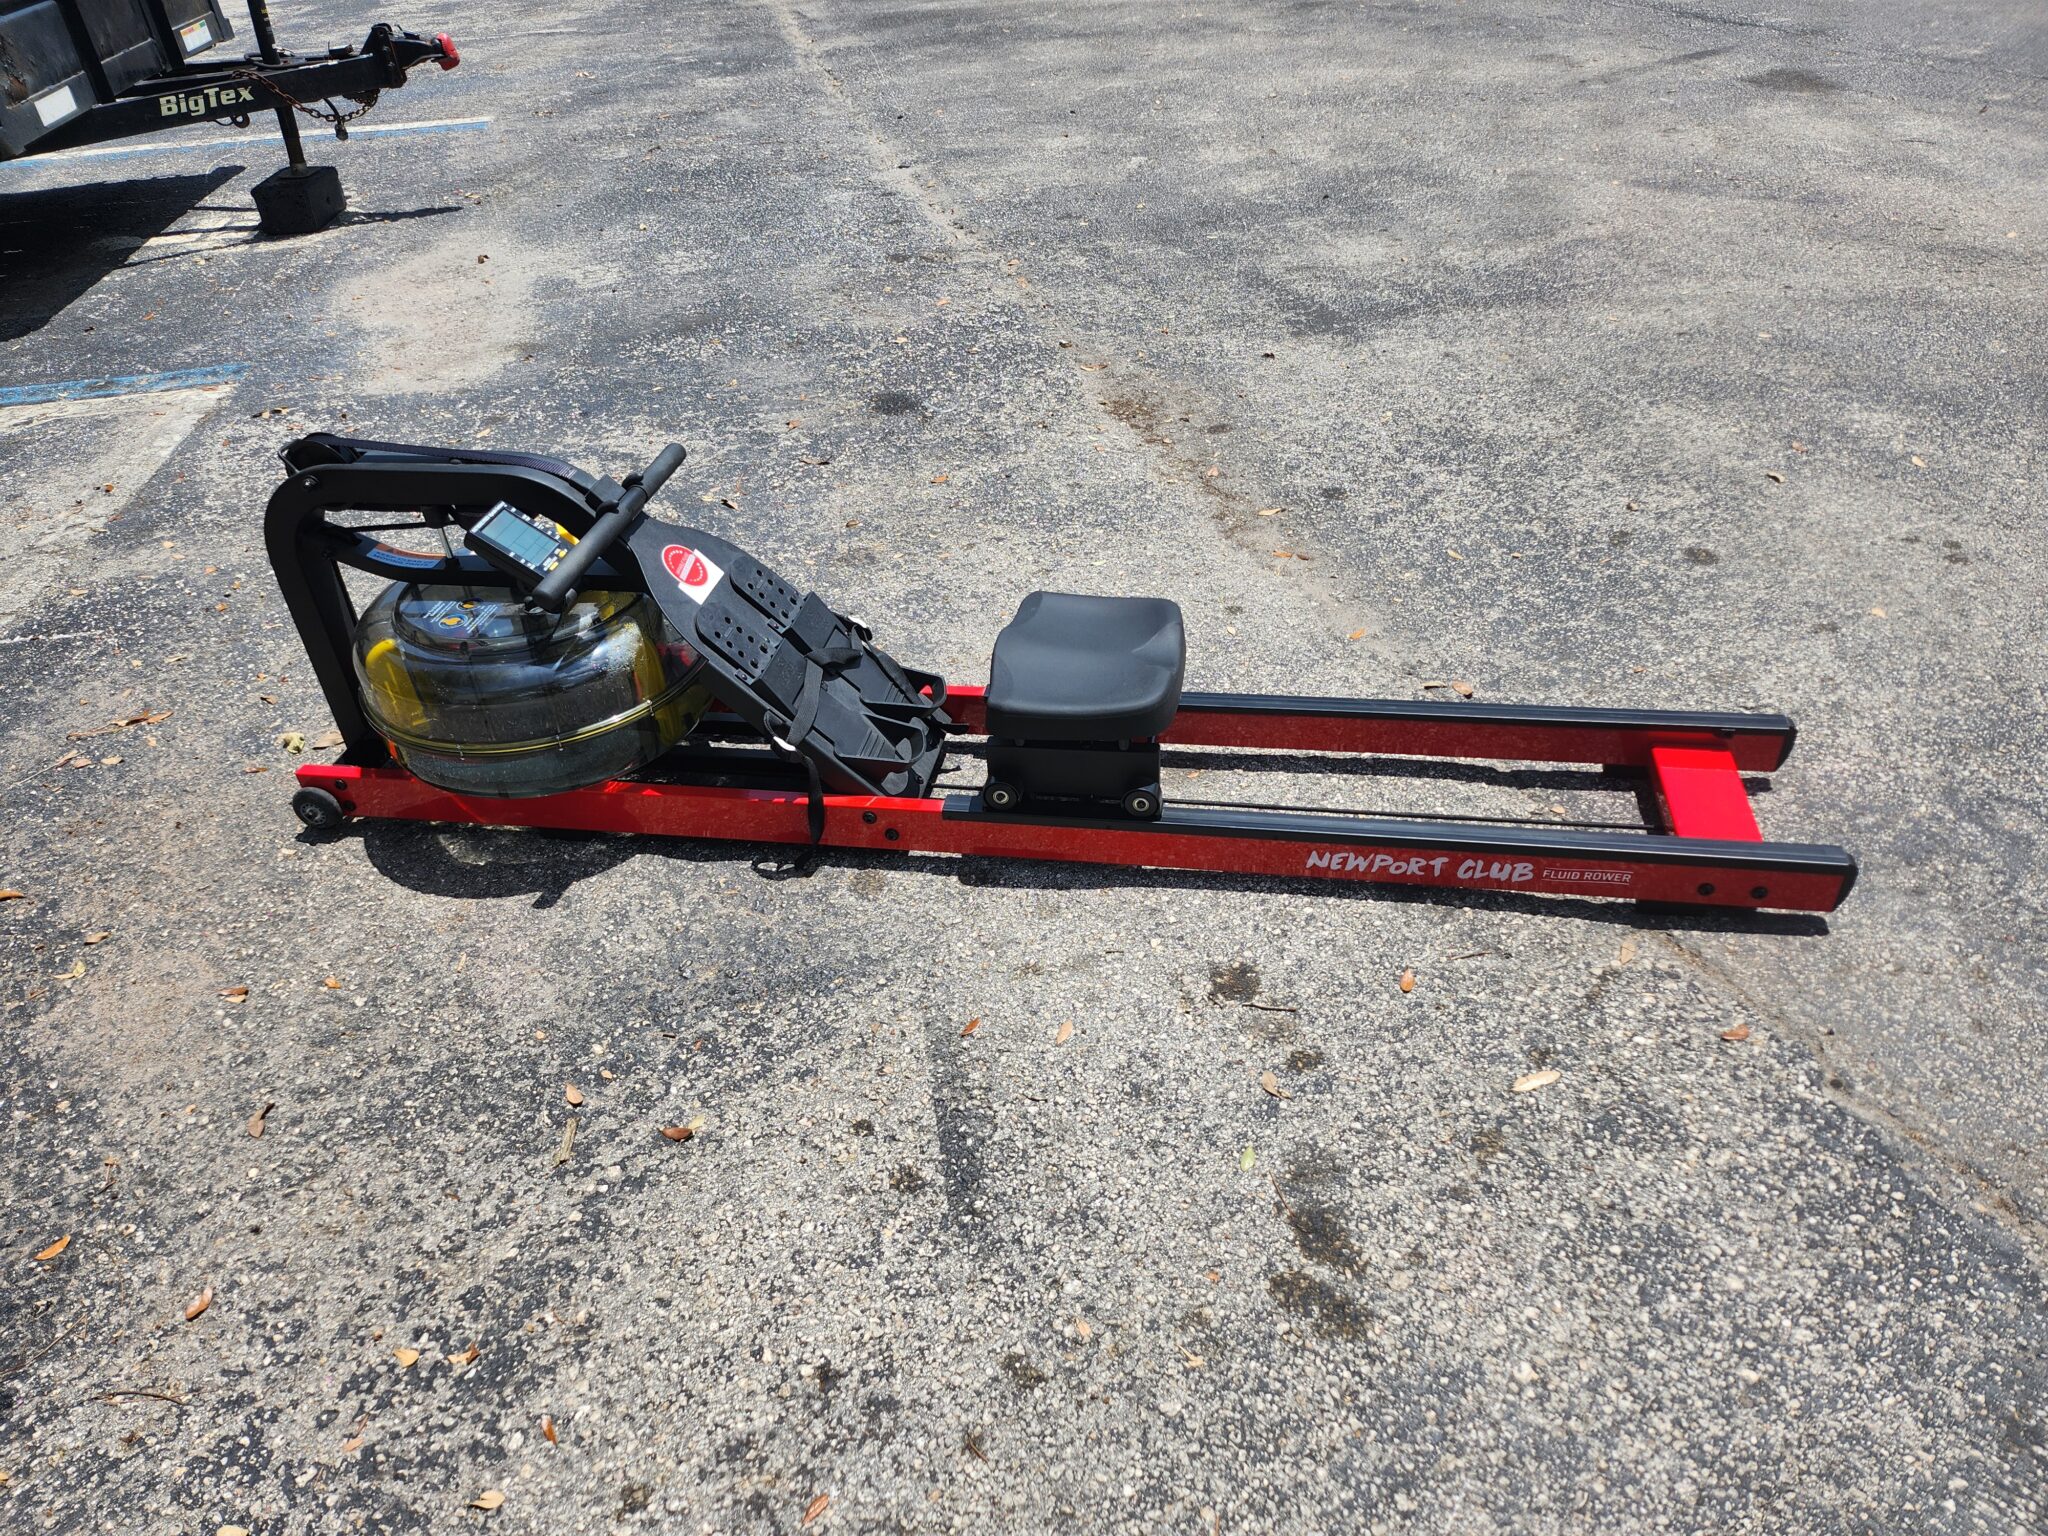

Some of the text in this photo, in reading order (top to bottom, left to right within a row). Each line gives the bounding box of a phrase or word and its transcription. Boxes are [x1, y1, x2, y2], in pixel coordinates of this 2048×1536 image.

[159, 86, 254, 116] BigTex
[1306, 850, 1534, 882] NEWPORT CLUB
[1543, 869, 1632, 883] FLUID ROWER
